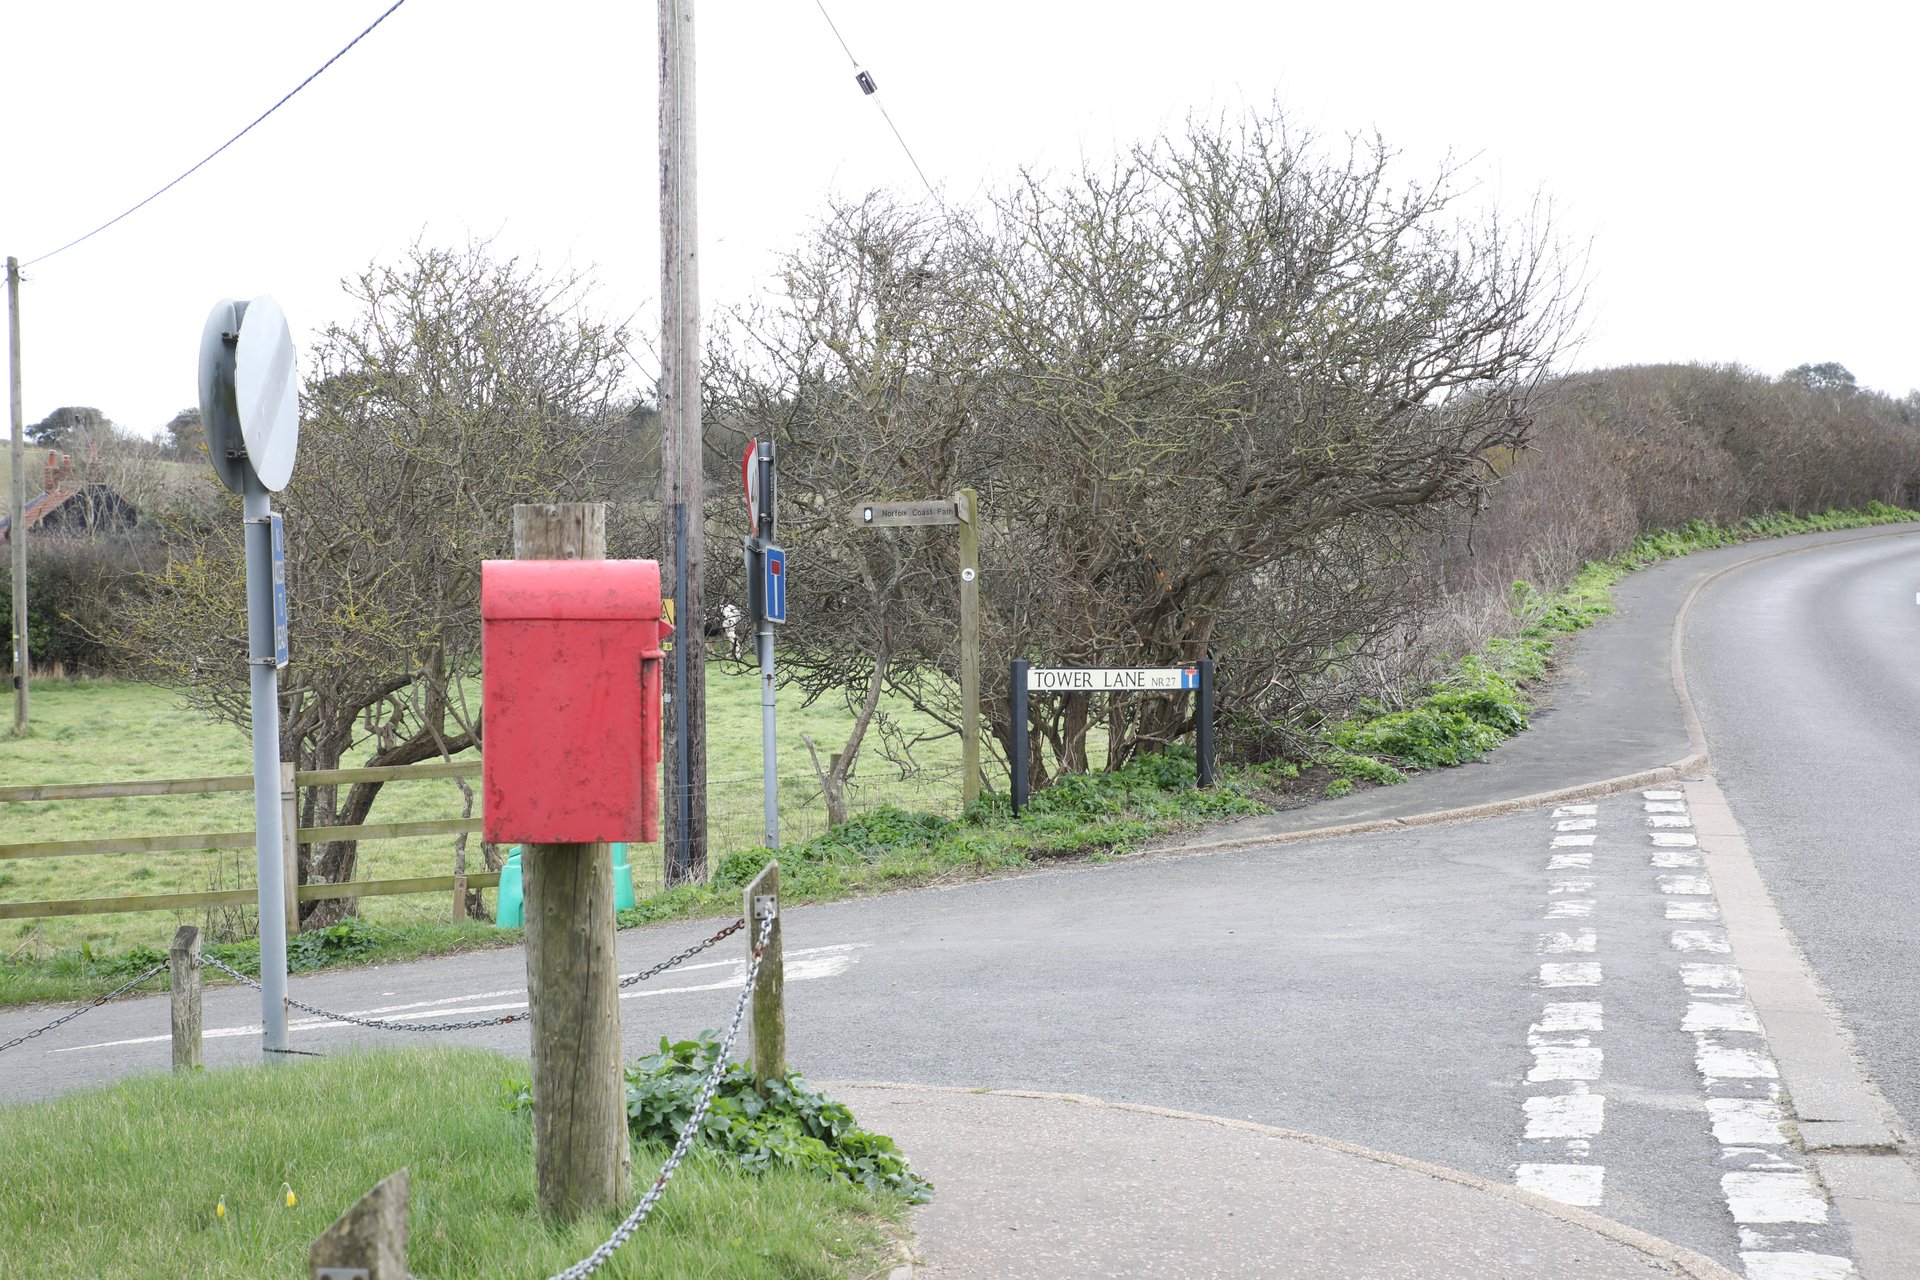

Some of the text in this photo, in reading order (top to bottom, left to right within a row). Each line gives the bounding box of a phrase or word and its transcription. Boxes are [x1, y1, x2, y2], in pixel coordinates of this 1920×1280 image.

[881, 509, 907, 517] Norfolk
[912, 508, 933, 516] Coast
[1034, 671, 1093, 688] TOWER
[1104, 671, 1146, 688] LANE
